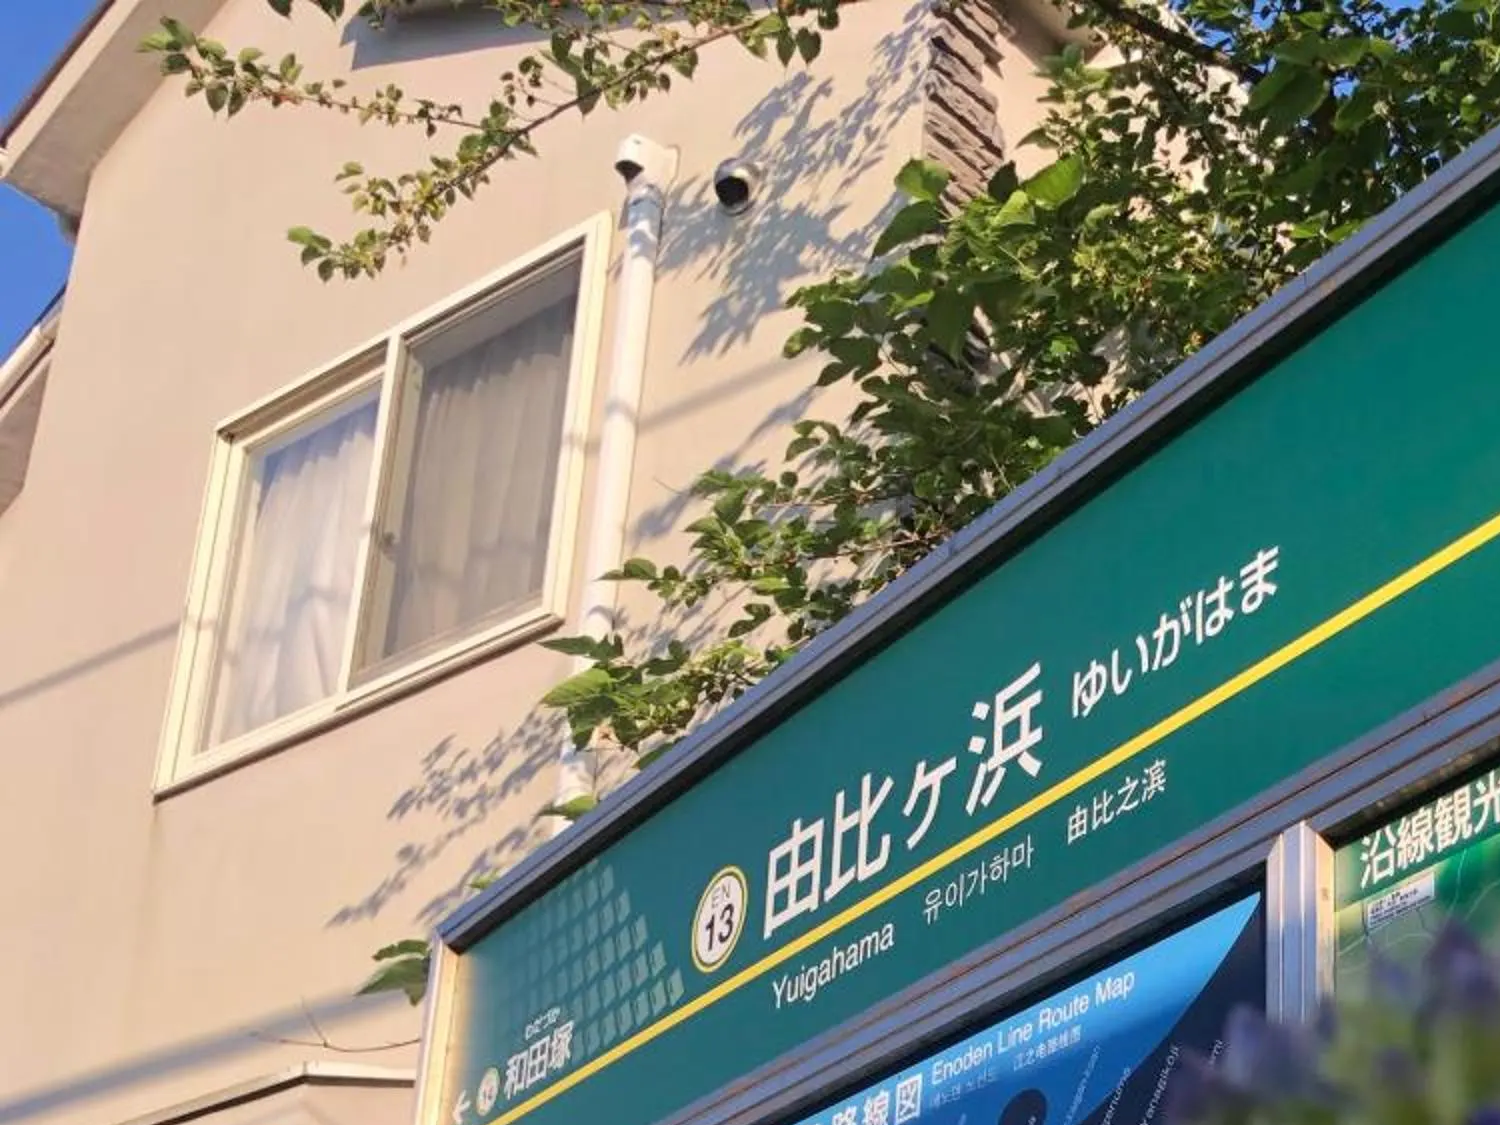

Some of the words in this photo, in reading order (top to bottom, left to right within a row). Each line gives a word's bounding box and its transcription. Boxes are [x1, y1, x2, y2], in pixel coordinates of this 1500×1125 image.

[1072, 546, 1280, 718] ゆいがはま
[1067, 758, 1168, 844] 由比之滨
[923, 834, 1034, 926] 유이가하마
[706, 903, 735, 951] 13
[771, 923, 895, 1010] Yuigahama
[931, 1040, 994, 1085] Enoden
[998, 1022, 1034, 1054] Line
[1038, 993, 1090, 1034] Route
[1095, 970, 1136, 1008] Map
